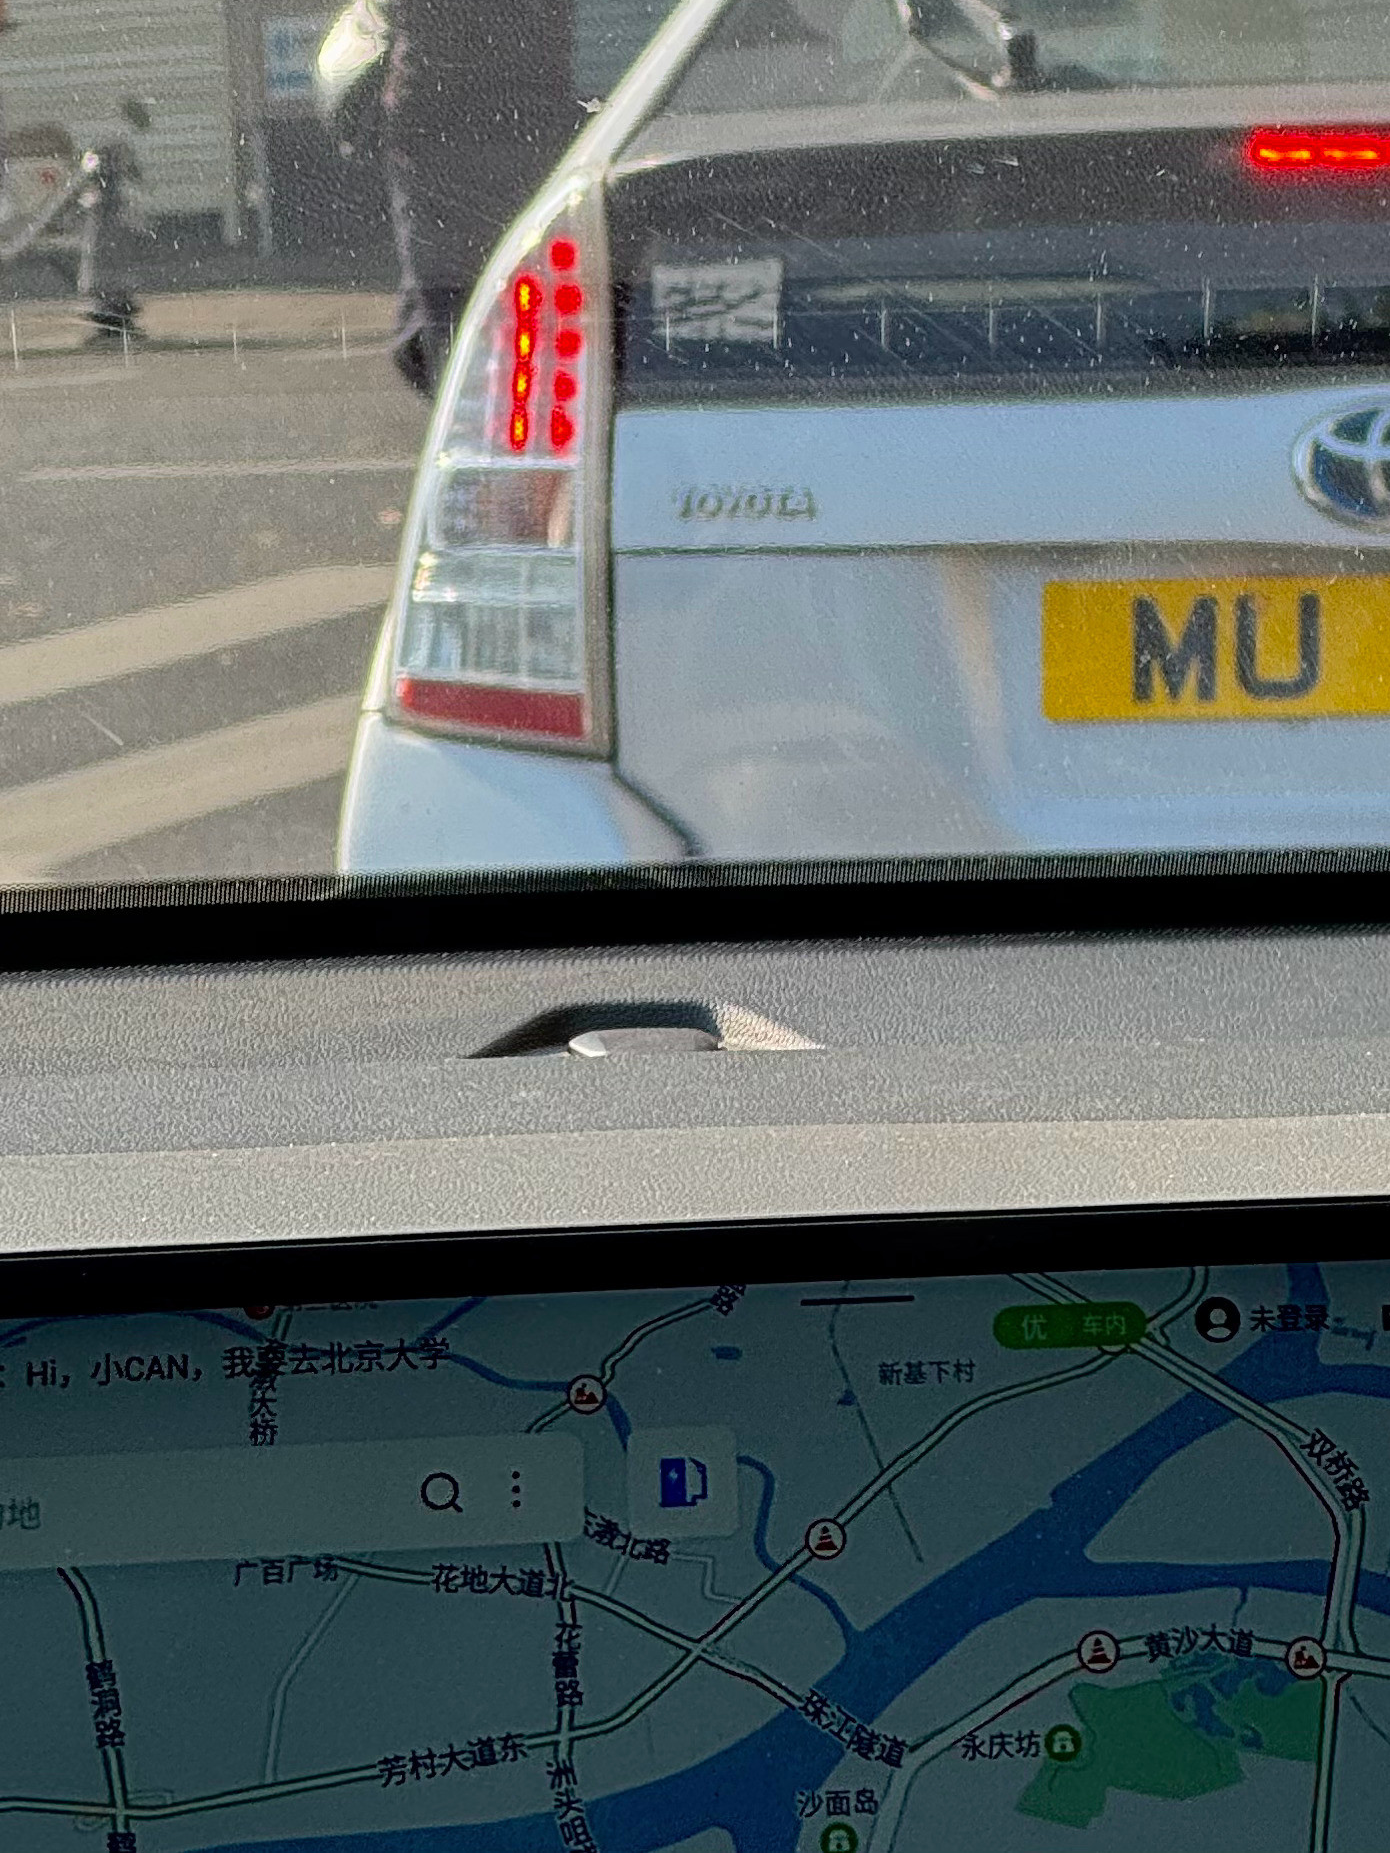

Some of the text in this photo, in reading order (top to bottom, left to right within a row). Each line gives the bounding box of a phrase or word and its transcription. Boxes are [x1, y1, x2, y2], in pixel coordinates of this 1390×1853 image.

[1131, 593, 1320, 704] MU
[1021, 1311, 1126, 1342] 优 车内
[1249, 1303, 1330, 1333] 未登录
[878, 1359, 976, 1386] 新基下村
[1302, 1428, 1370, 1512] 双桥路
[0, 1498, 41, 1529] 地
[234, 1557, 338, 1587] 广百广场
[432, 1563, 574, 1603] 花地大道北
[1145, 1623, 1255, 1663] 黄沙大道
[86, 1659, 125, 1749] 鹤洞路
[799, 1688, 907, 1768] 珠江隧道
[961, 1731, 1041, 1760] 永庆坊
[378, 1732, 527, 1788] 芳村大道东
[796, 1788, 879, 1818] 沙面岛
